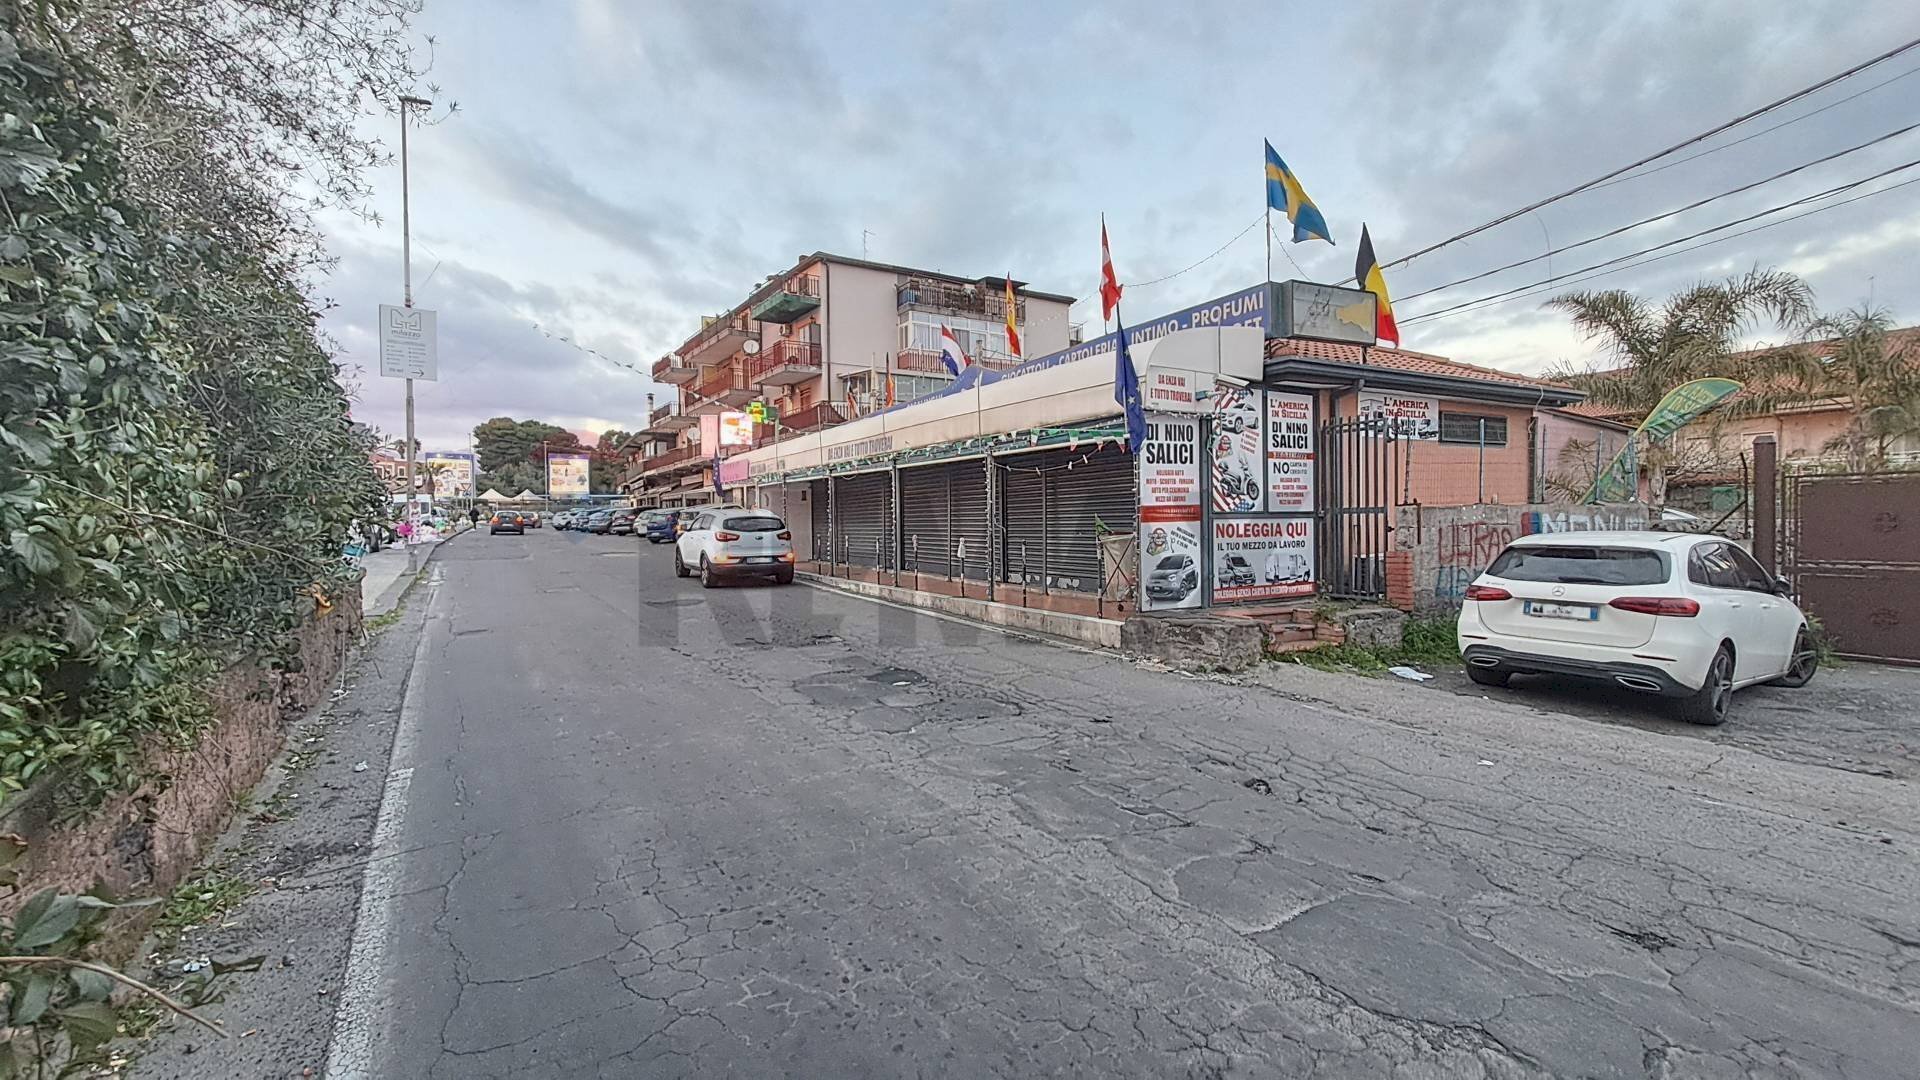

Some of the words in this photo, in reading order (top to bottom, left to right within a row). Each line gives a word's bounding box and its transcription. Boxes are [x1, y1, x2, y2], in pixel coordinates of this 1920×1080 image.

[1131, 319, 1178, 344] INTIMO
[1192, 292, 1264, 328] PROFUMI
[1270, 398, 1309, 411] L'AMERICA
[1384, 396, 1429, 410] L'AMERICA
[1272, 410, 1279, 418] IN
[1282, 410, 1307, 419] SICILIA
[1385, 408, 1394, 417] IN
[1395, 407, 1427, 418] SICILIA
[1146, 423, 1159, 441] DI
[1164, 423, 1194, 442] NINO
[1272, 421, 1282, 433] DI
[1286, 422, 1308, 435] NINO
[1272, 434, 1308, 449] SALICI
[1145, 442, 1194, 465] SALICI
[1273, 461, 1290, 474] NO
[1215, 522, 1283, 539] NOLEGGIA
[1286, 522, 1307, 538] QUI
[1217, 543, 1224, 551] IL
[1226, 542, 1240, 551] TUO
[1242, 542, 1266, 550] MEZZO
[1267, 541, 1277, 549] DA
[1279, 540, 1306, 549] LAVORO
